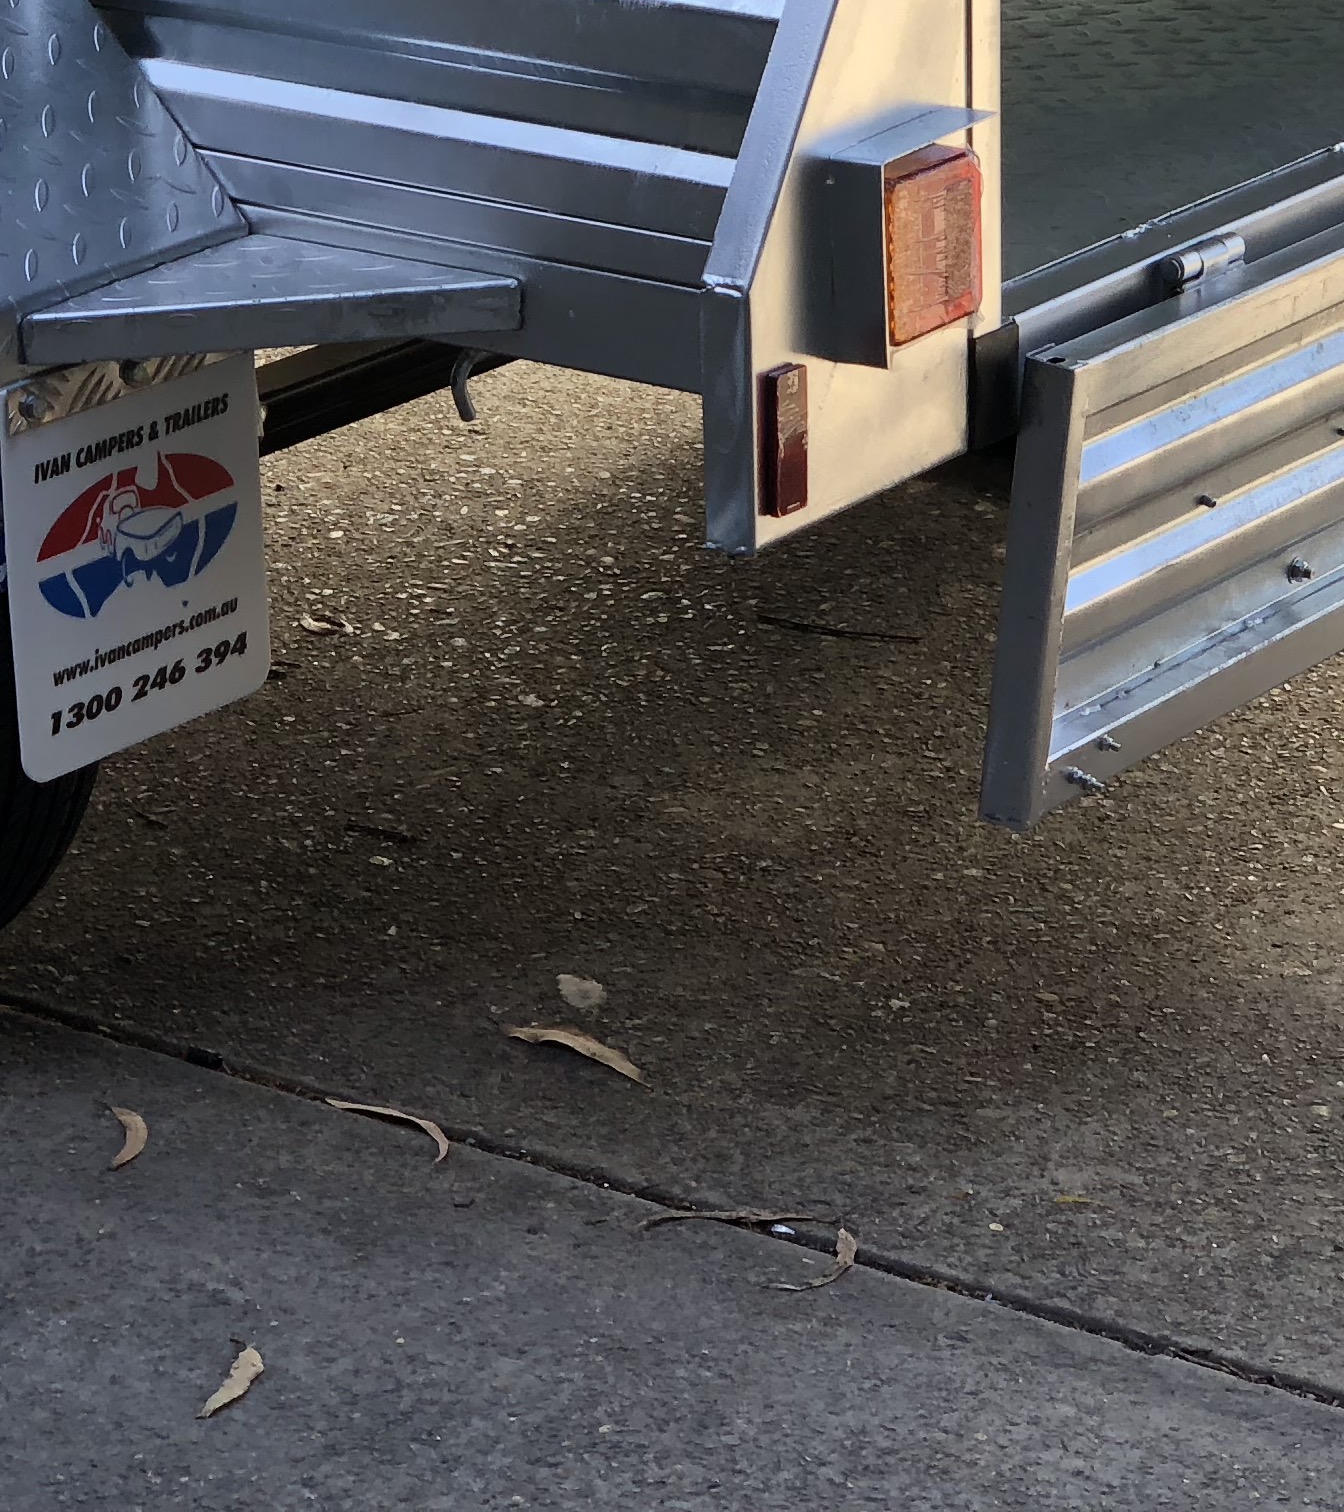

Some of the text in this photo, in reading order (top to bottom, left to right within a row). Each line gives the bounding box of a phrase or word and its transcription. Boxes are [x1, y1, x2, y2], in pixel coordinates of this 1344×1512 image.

[34, 392, 229, 484] IVAN CAMPERS & TRAILERS
[51, 631, 248, 736] 1300 246 394
[53, 597, 238, 687] www.ivancampers.com.au
